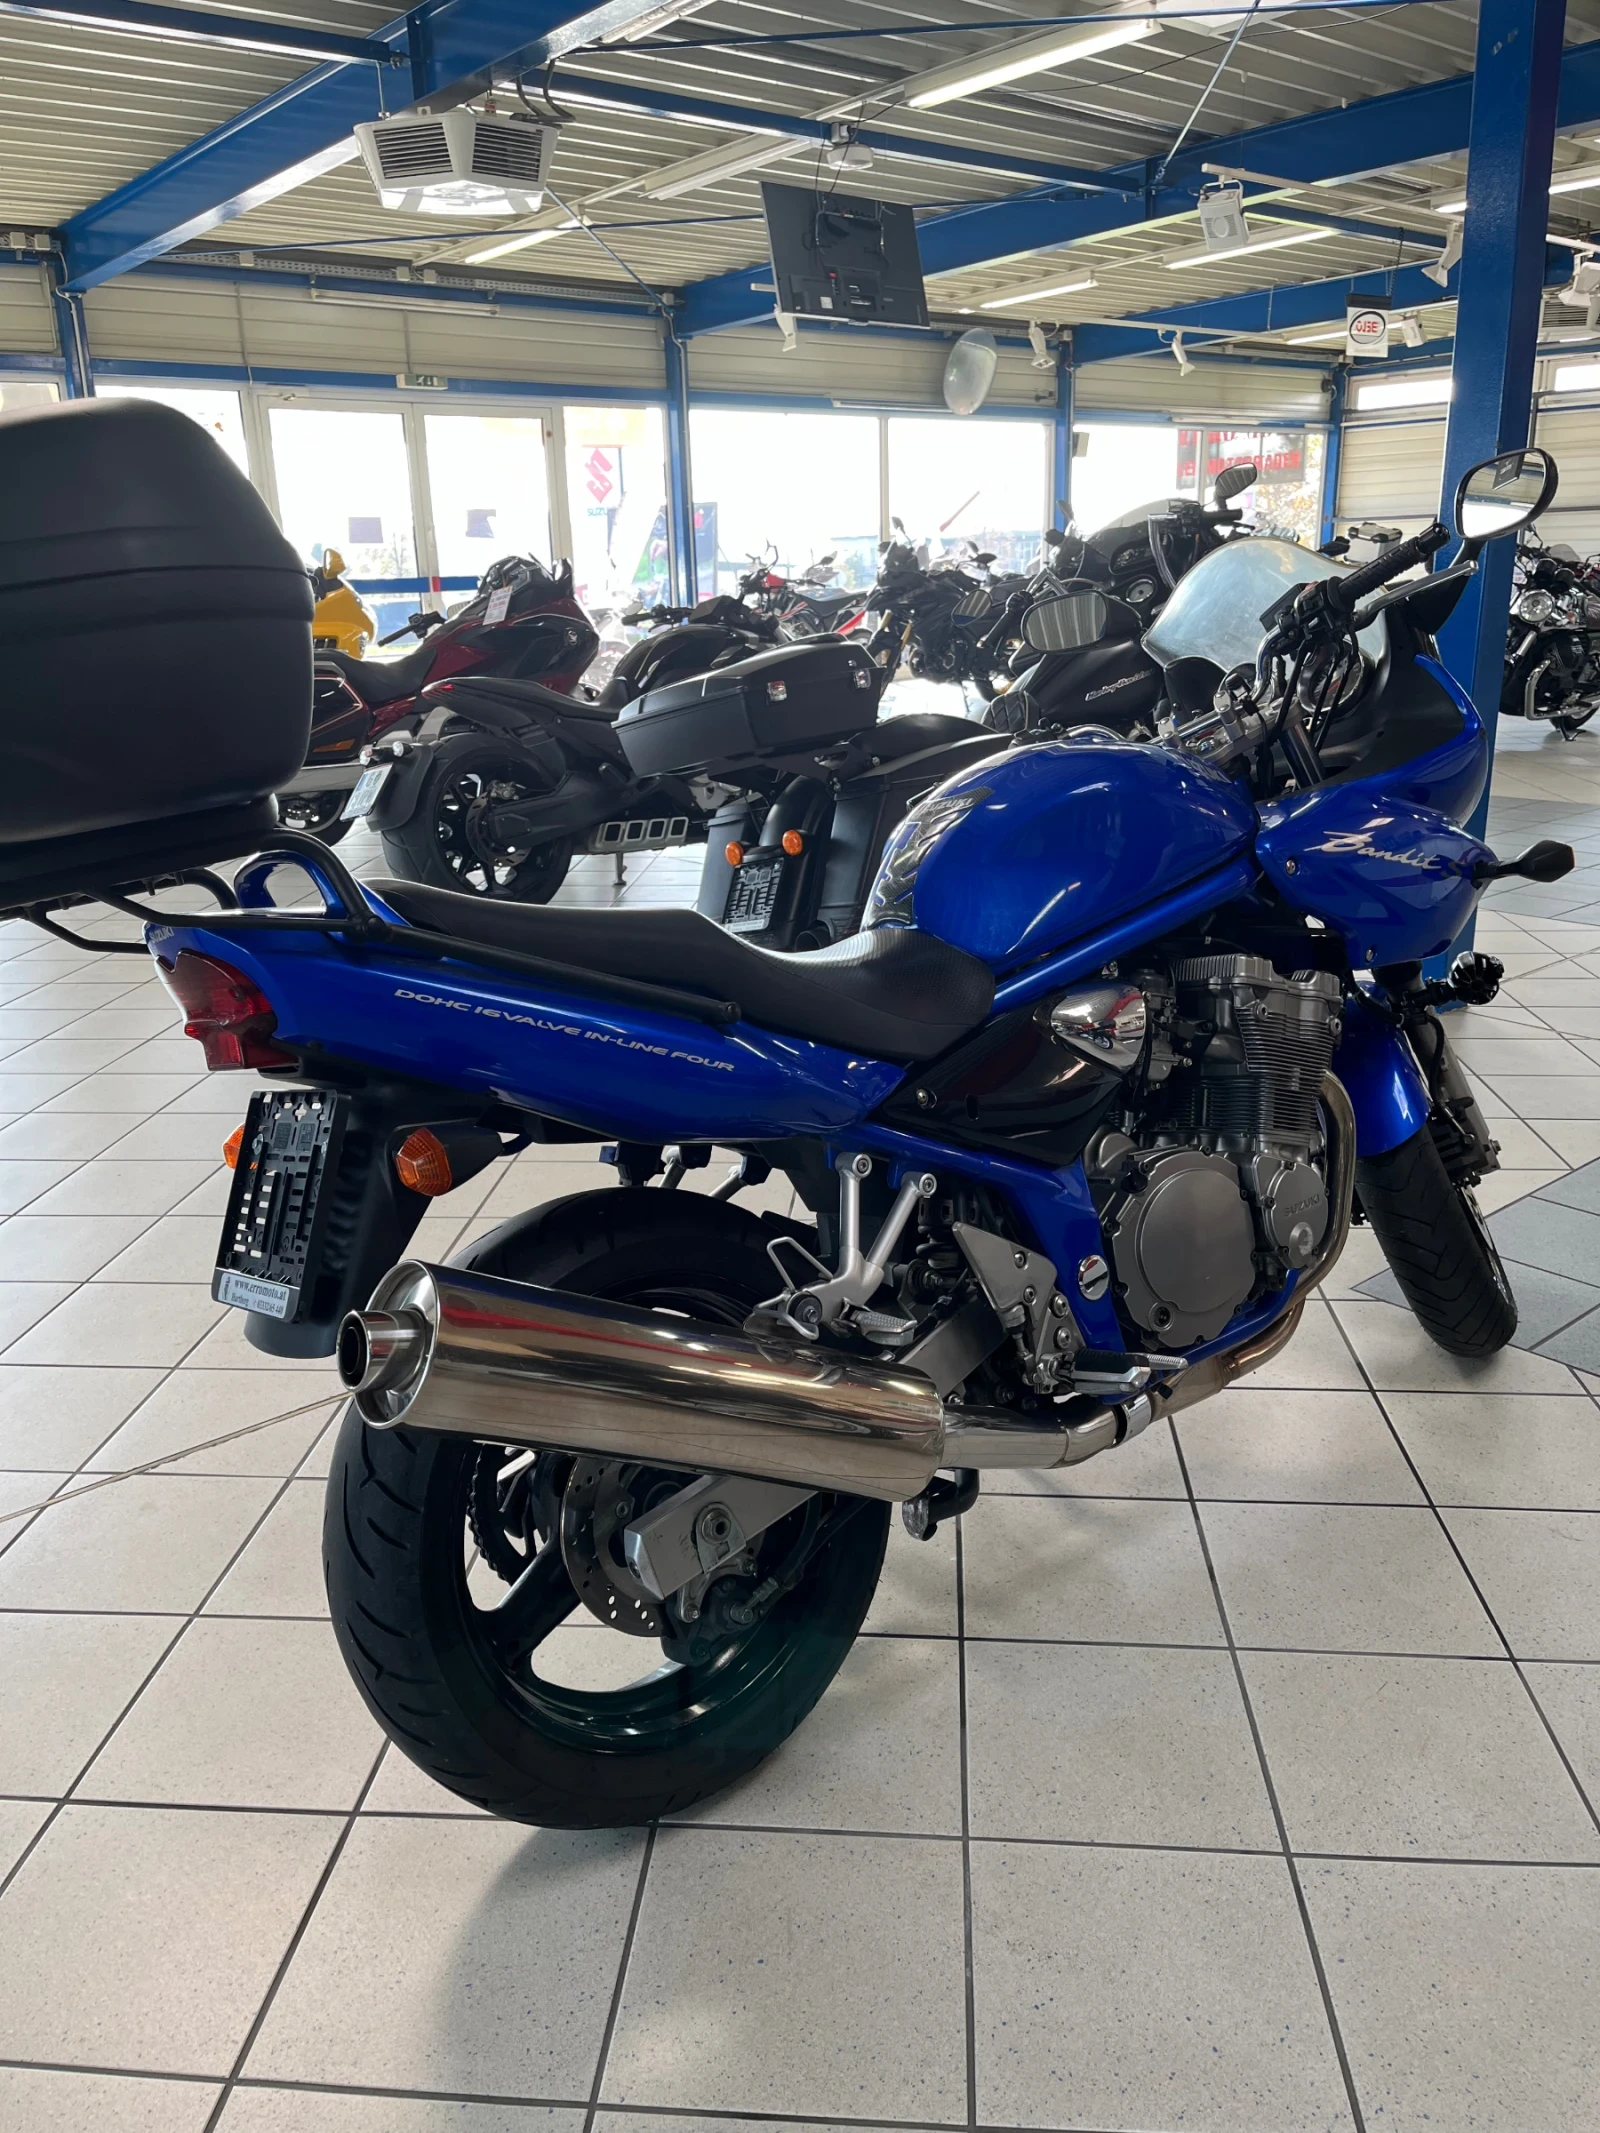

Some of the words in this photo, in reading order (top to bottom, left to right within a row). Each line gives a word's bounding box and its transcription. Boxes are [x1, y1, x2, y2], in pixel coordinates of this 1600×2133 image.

[1304, 818, 1441, 870] Bandit
[394, 989, 472, 1012] DOHC
[584, 1031, 669, 1056] IN-LINE
[670, 1051, 735, 1072] FOUR
[1283, 1194, 1320, 1217] SUZUKI
